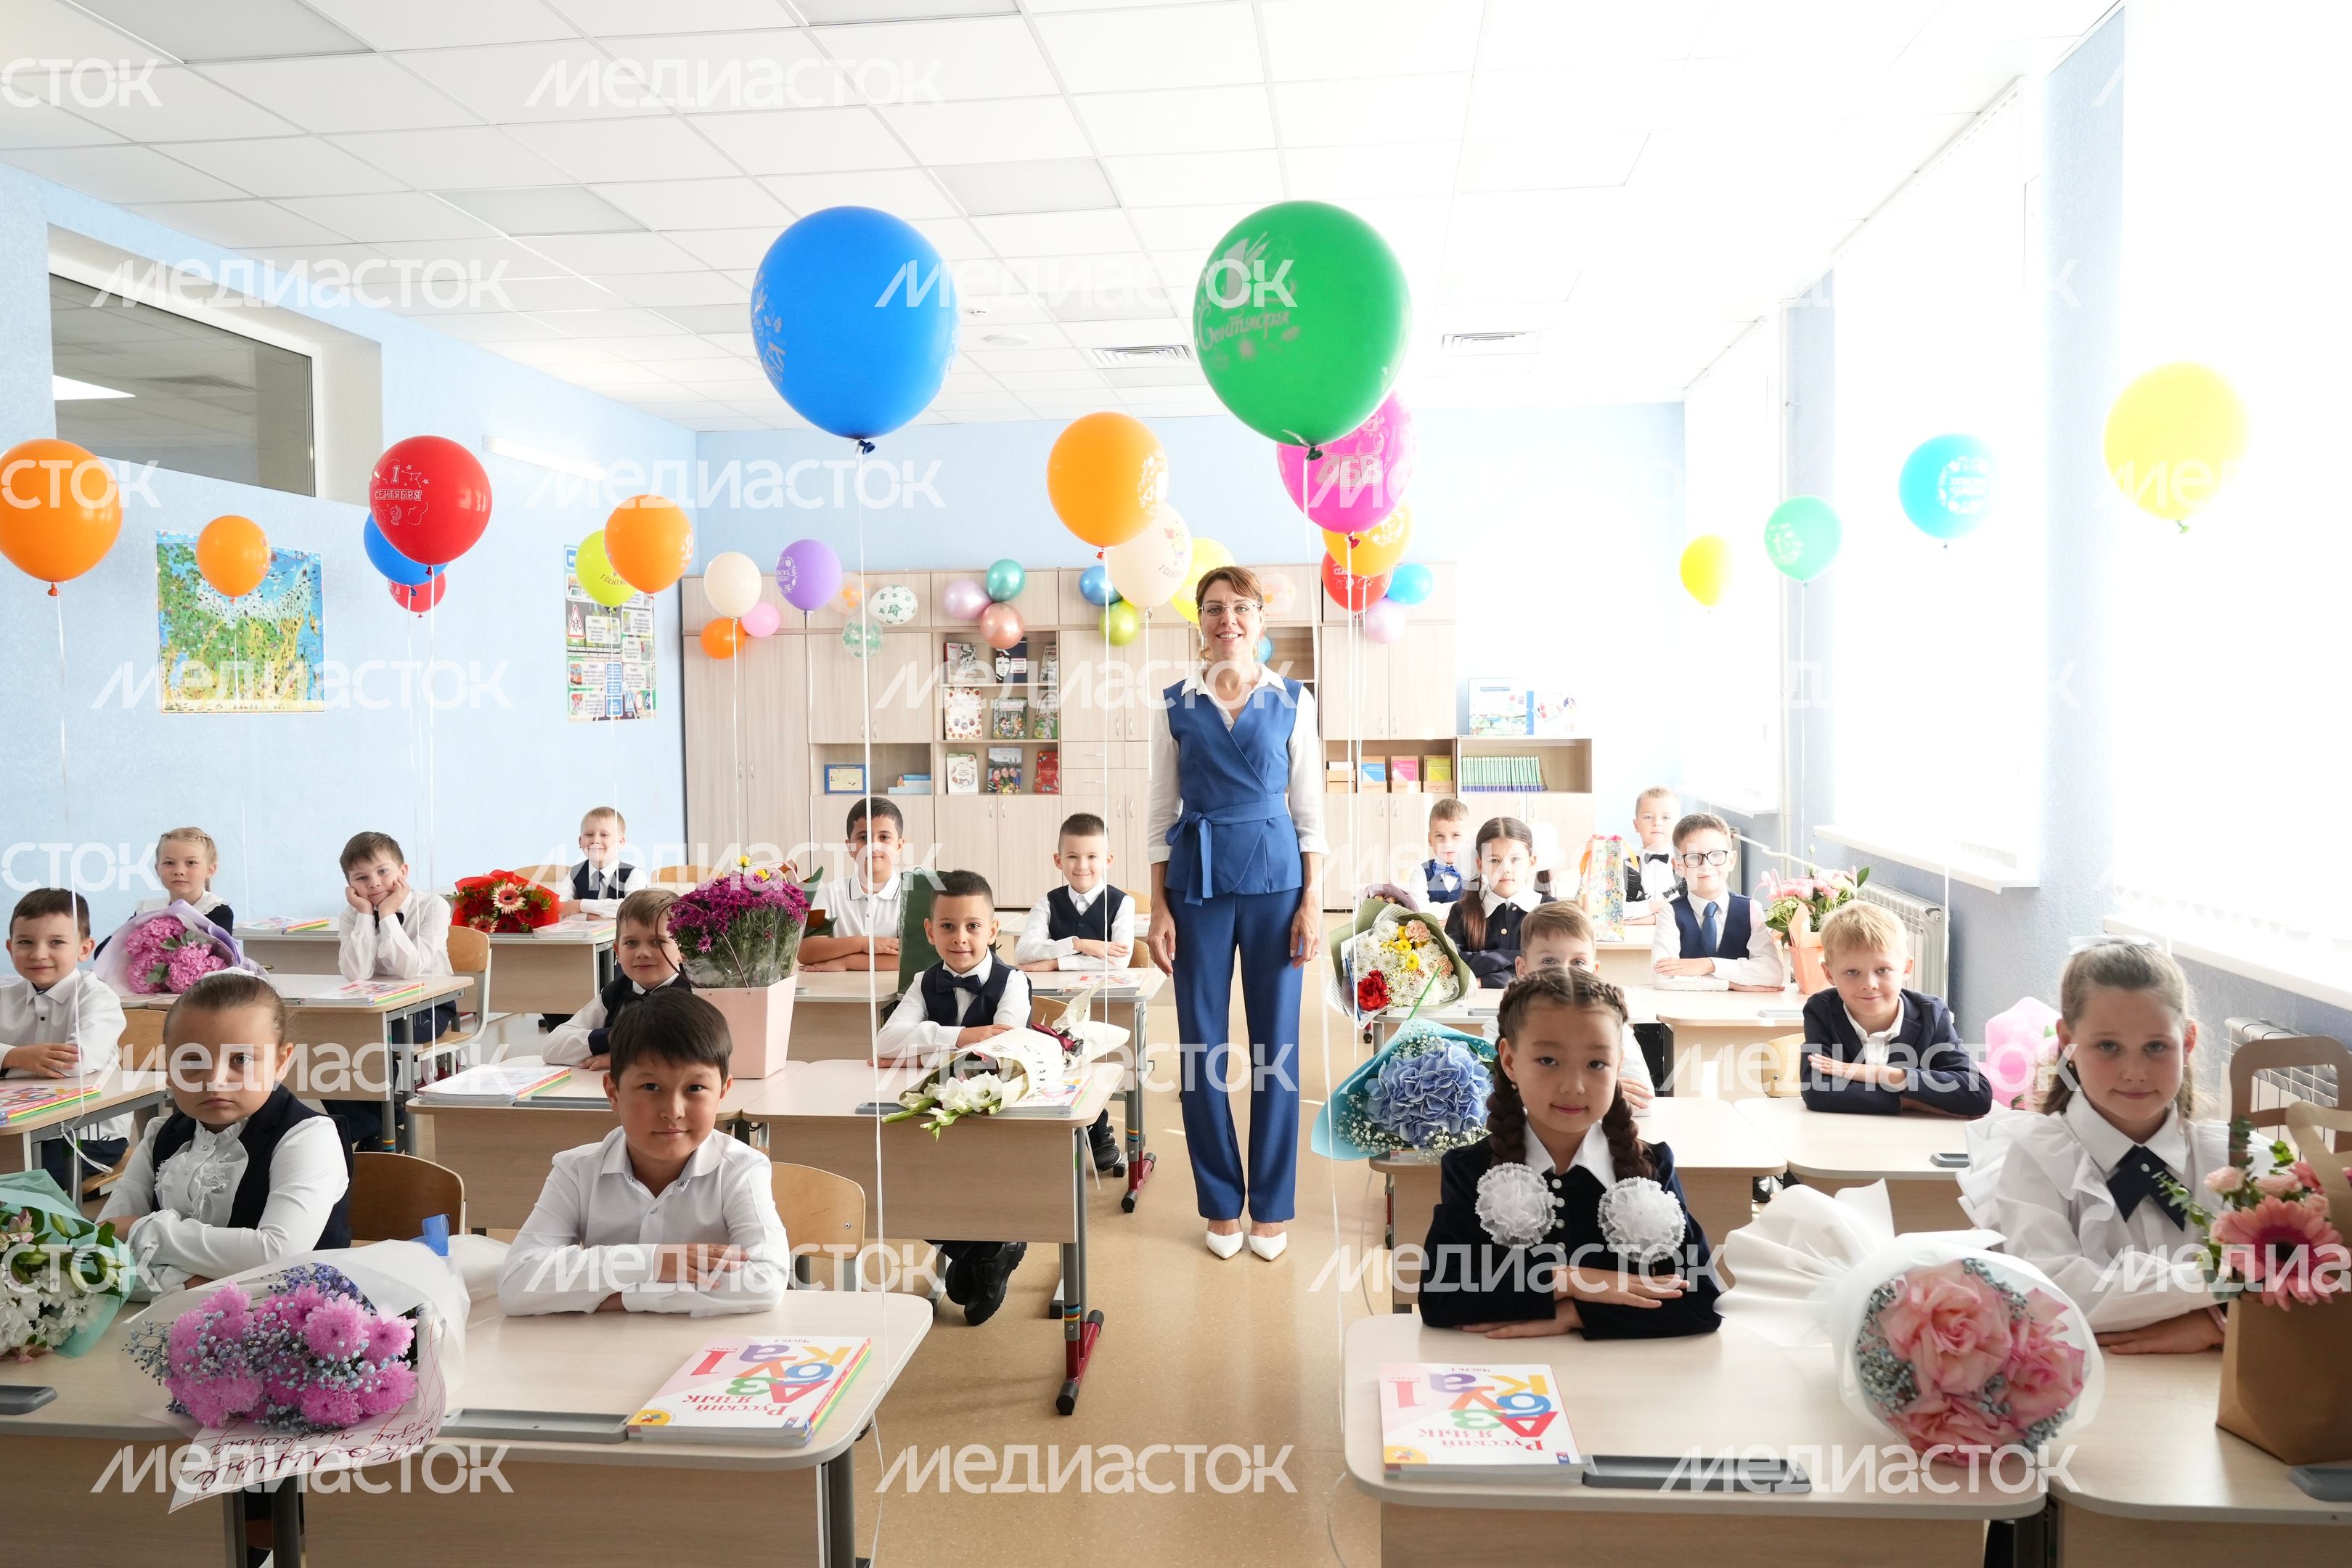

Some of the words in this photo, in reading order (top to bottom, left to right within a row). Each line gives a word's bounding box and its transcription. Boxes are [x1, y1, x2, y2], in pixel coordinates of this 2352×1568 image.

[391, 465, 401, 484] 1
[1315, 453, 1384, 488] АБВ
[375, 489, 422, 501] СЕНТЯБРЯ
[604, 576, 627, 585] СЕНТЯ
[690, 1349, 737, 1376] 1
[1389, 1380, 1426, 1408] 1
[693, 1402, 789, 1416] Русский
[1442, 1437, 1545, 1452] Русский
